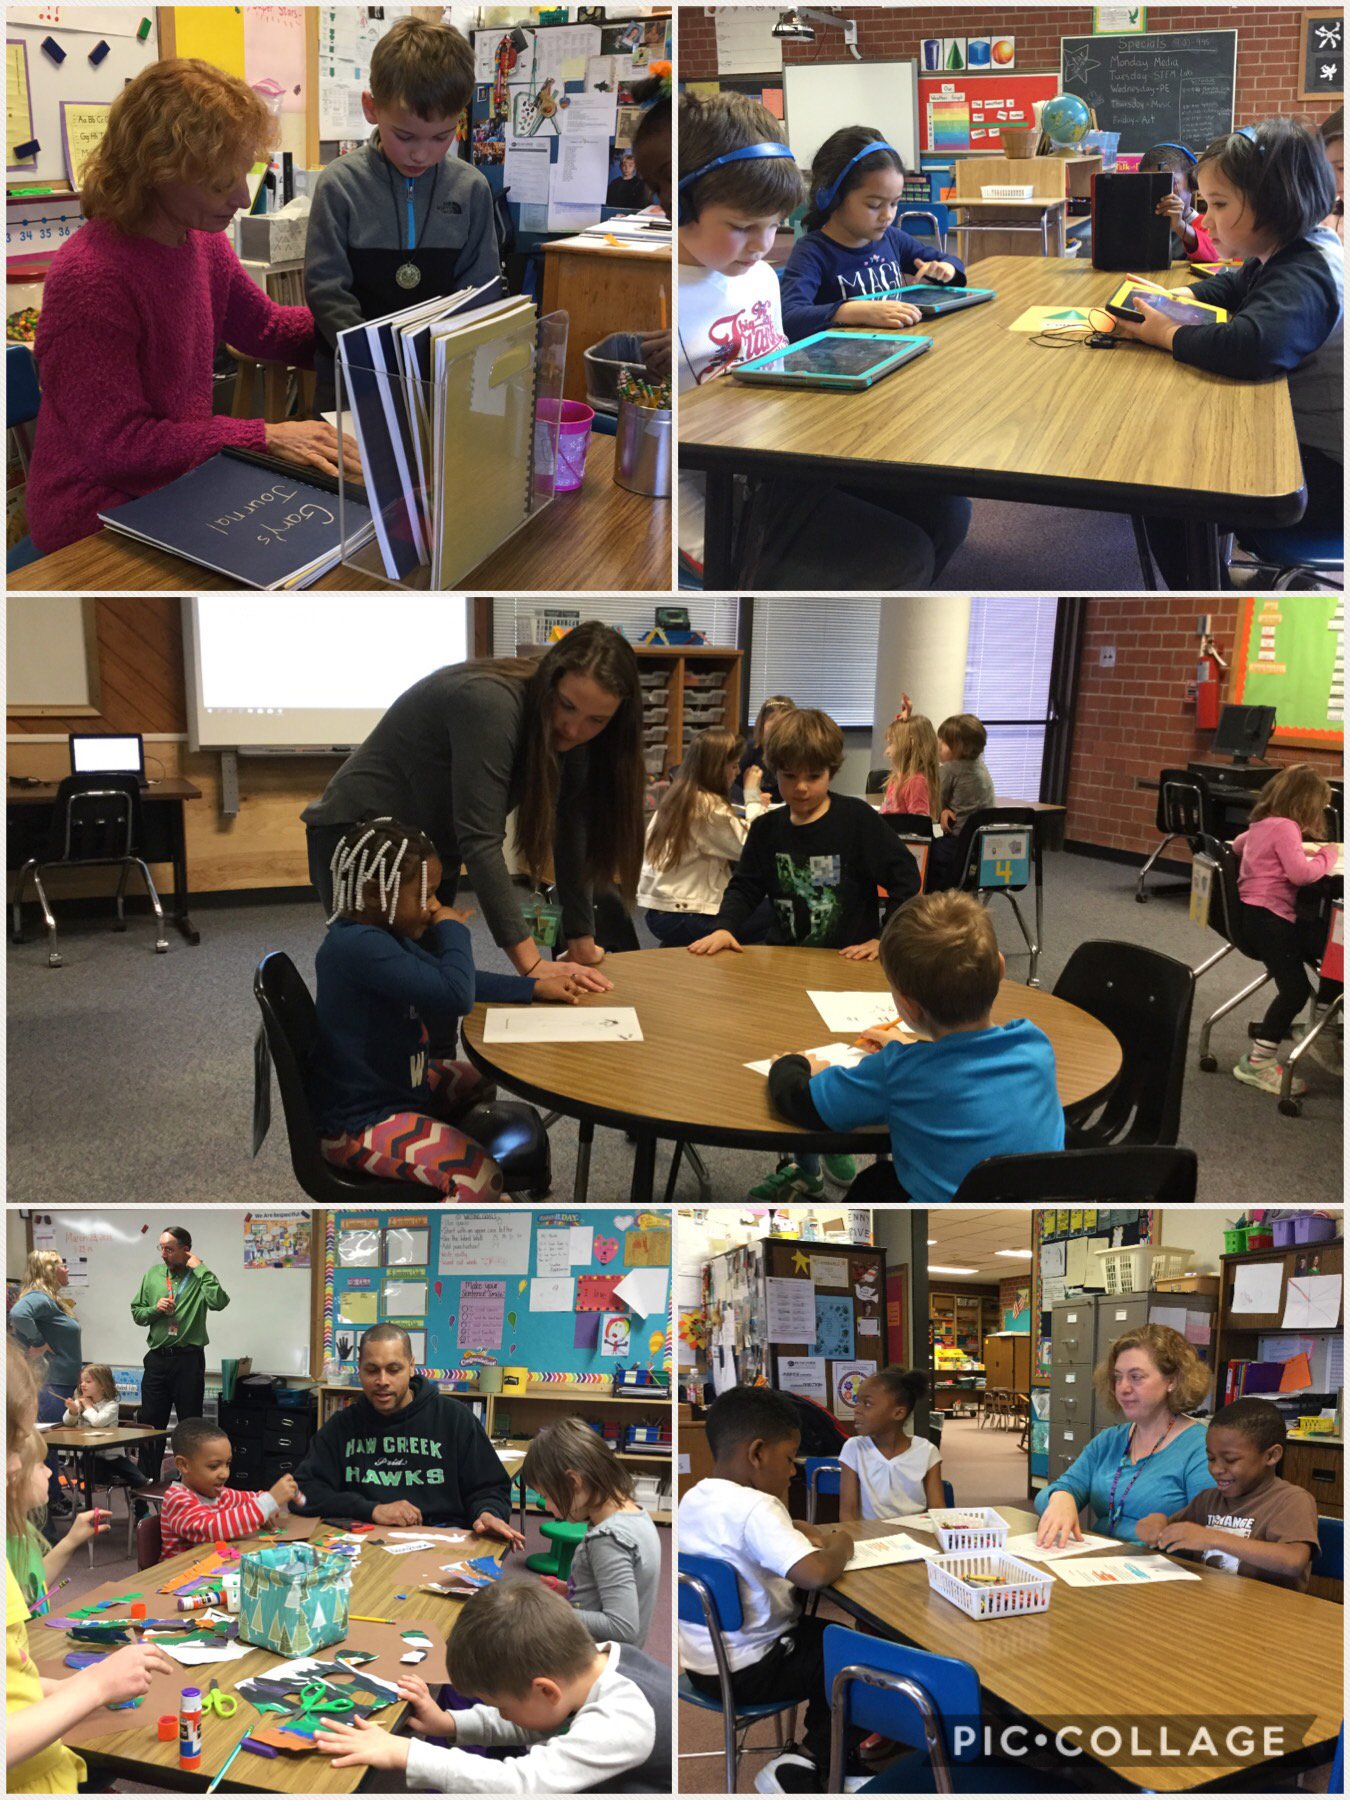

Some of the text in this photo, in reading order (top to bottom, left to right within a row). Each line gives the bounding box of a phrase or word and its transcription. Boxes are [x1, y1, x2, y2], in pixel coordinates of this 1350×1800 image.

[1118, 37, 1167, 51] Specials
[1110, 56, 1179, 68] Monday Media
[19, 230, 33, 242] 34
[39, 228, 52, 239] 35
[58, 226, 70, 237] 36
[206, 485, 298, 536] Journal
[256, 503, 335, 545] Gary's
[995, 860, 1013, 884] 4
[464, 1281, 498, 1291] Make your
[345, 1436, 443, 1459] HAW CREEK
[345, 1466, 445, 1486] HAWKS
